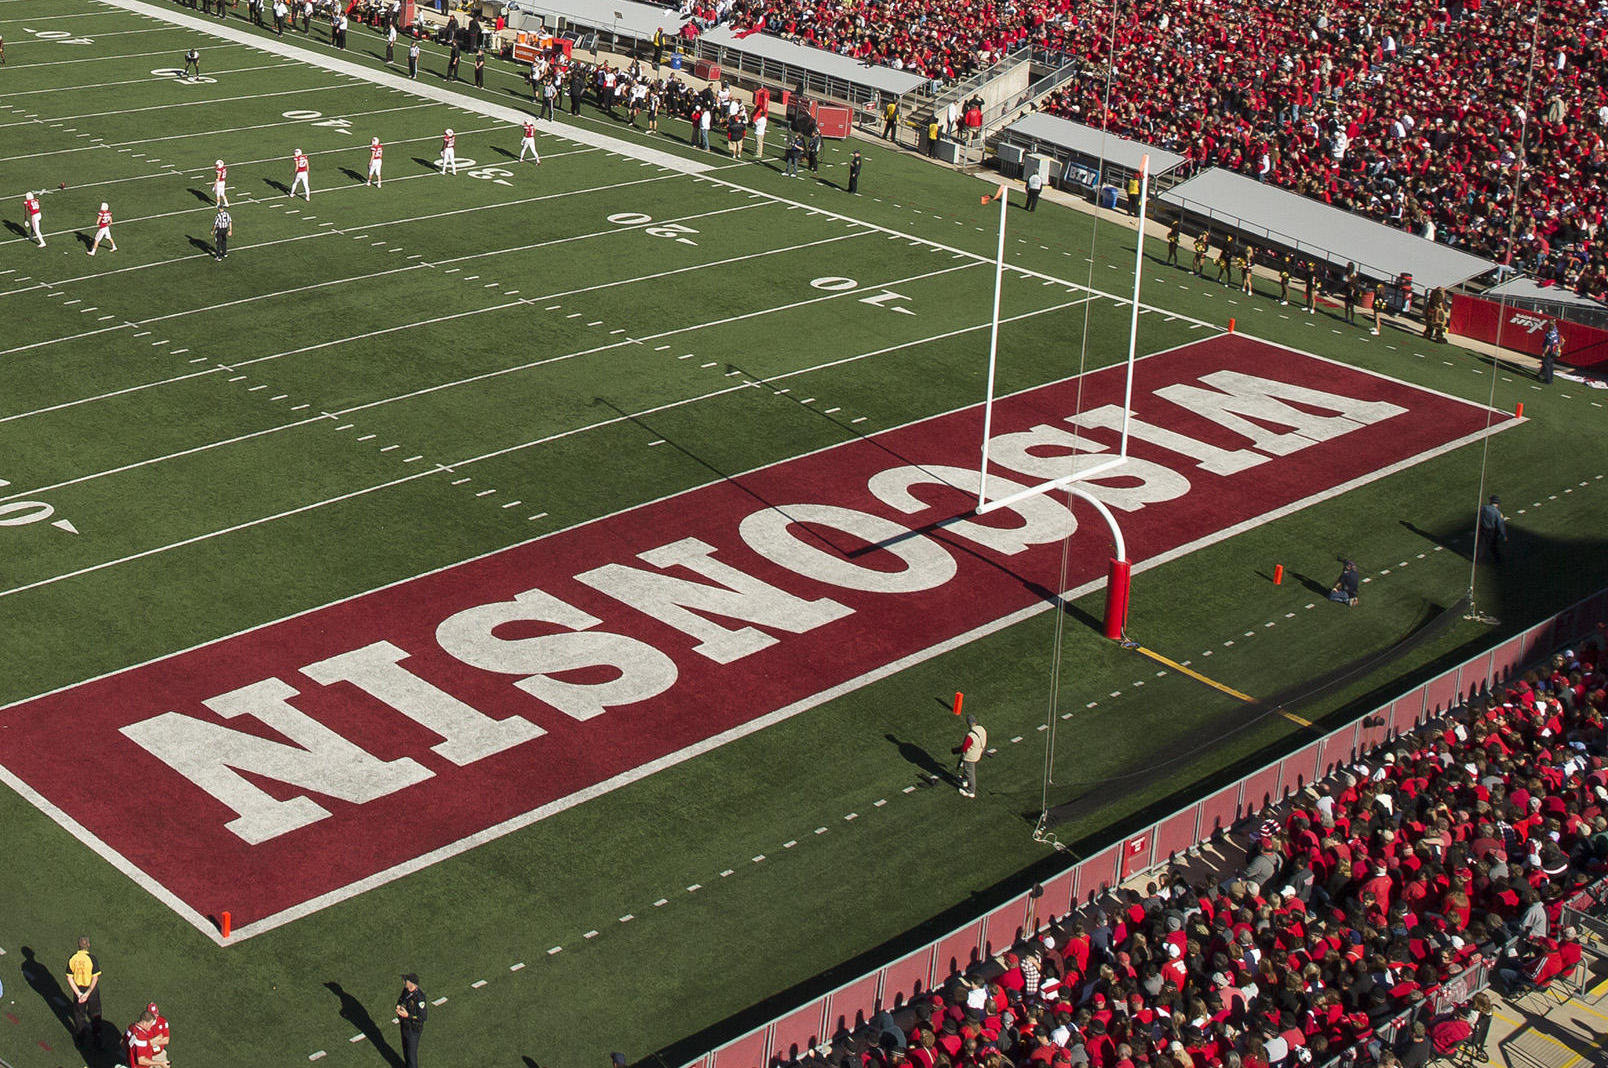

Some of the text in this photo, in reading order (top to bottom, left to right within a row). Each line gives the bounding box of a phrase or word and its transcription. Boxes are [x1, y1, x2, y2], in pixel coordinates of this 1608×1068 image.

[606, 212, 699, 239] 20
[809, 275, 912, 308] 10
[119, 368, 1409, 846] WISCONSIN
